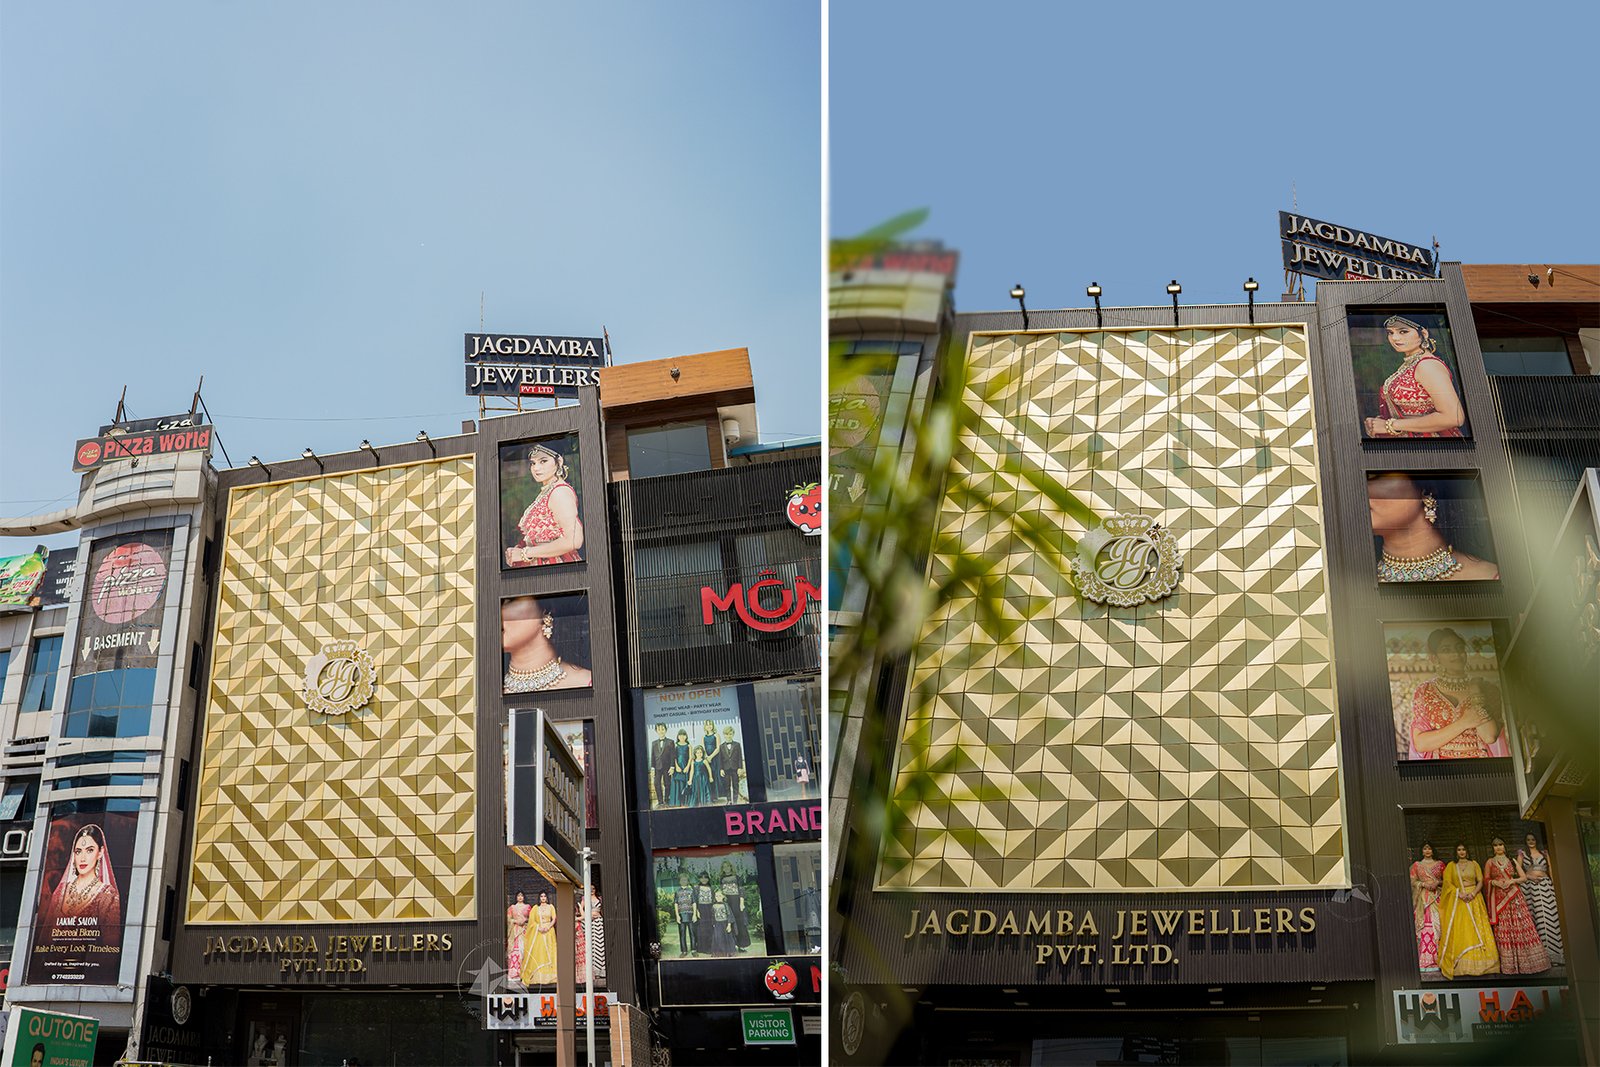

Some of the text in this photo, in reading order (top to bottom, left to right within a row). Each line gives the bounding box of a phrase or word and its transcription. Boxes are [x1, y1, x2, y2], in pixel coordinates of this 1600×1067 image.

[1287, 214, 1428, 265] JAGDAMBA
[469, 336, 599, 357] JAGDAMBA
[471, 366, 600, 387] JEWELLERS
[538, 386, 553, 394] LTD
[93, 631, 145, 651] BASEMENT
[659, 688, 721, 702] NOW OPEN
[78, 917, 99, 926] SALON
[904, 909, 1099, 938] JAGDAMBA
[1112, 907, 1316, 939] JEWELLERS
[203, 936, 319, 955] JAGDAMBA
[326, 934, 452, 955] JEWELLERS
[1035, 944, 1179, 964] PVT. LTD.
[280, 958, 367, 972] PVT. LTD.
[29, 1015, 94, 1042] QUTONE
[748, 1029, 789, 1038] PARKING
[749, 1019, 786, 1029] VISITOR
